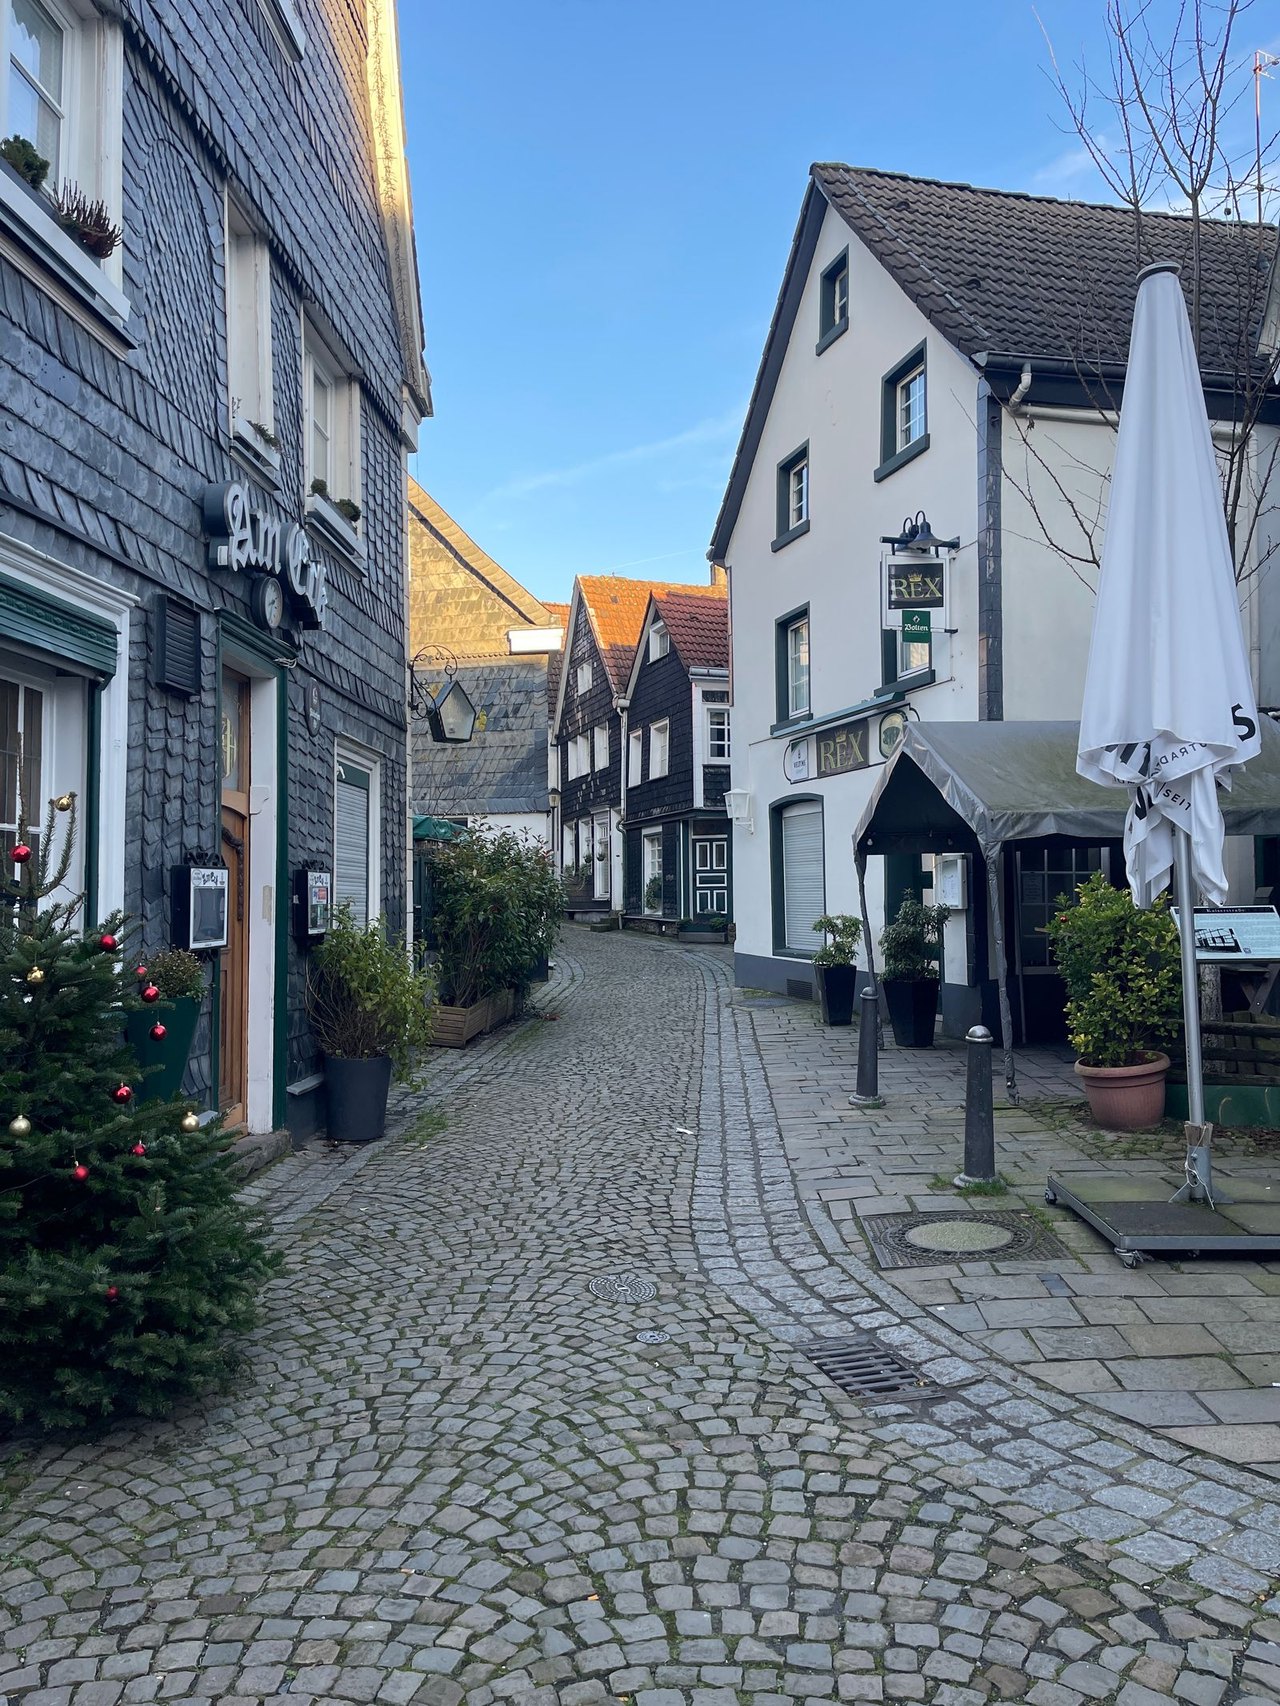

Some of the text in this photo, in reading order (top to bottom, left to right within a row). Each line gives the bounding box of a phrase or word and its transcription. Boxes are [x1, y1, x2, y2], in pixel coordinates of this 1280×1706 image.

[225, 479, 281, 574] Am
[890, 577, 942, 599] REX
[904, 623, 929, 632] Bolten
[819, 730, 864, 772] REX
